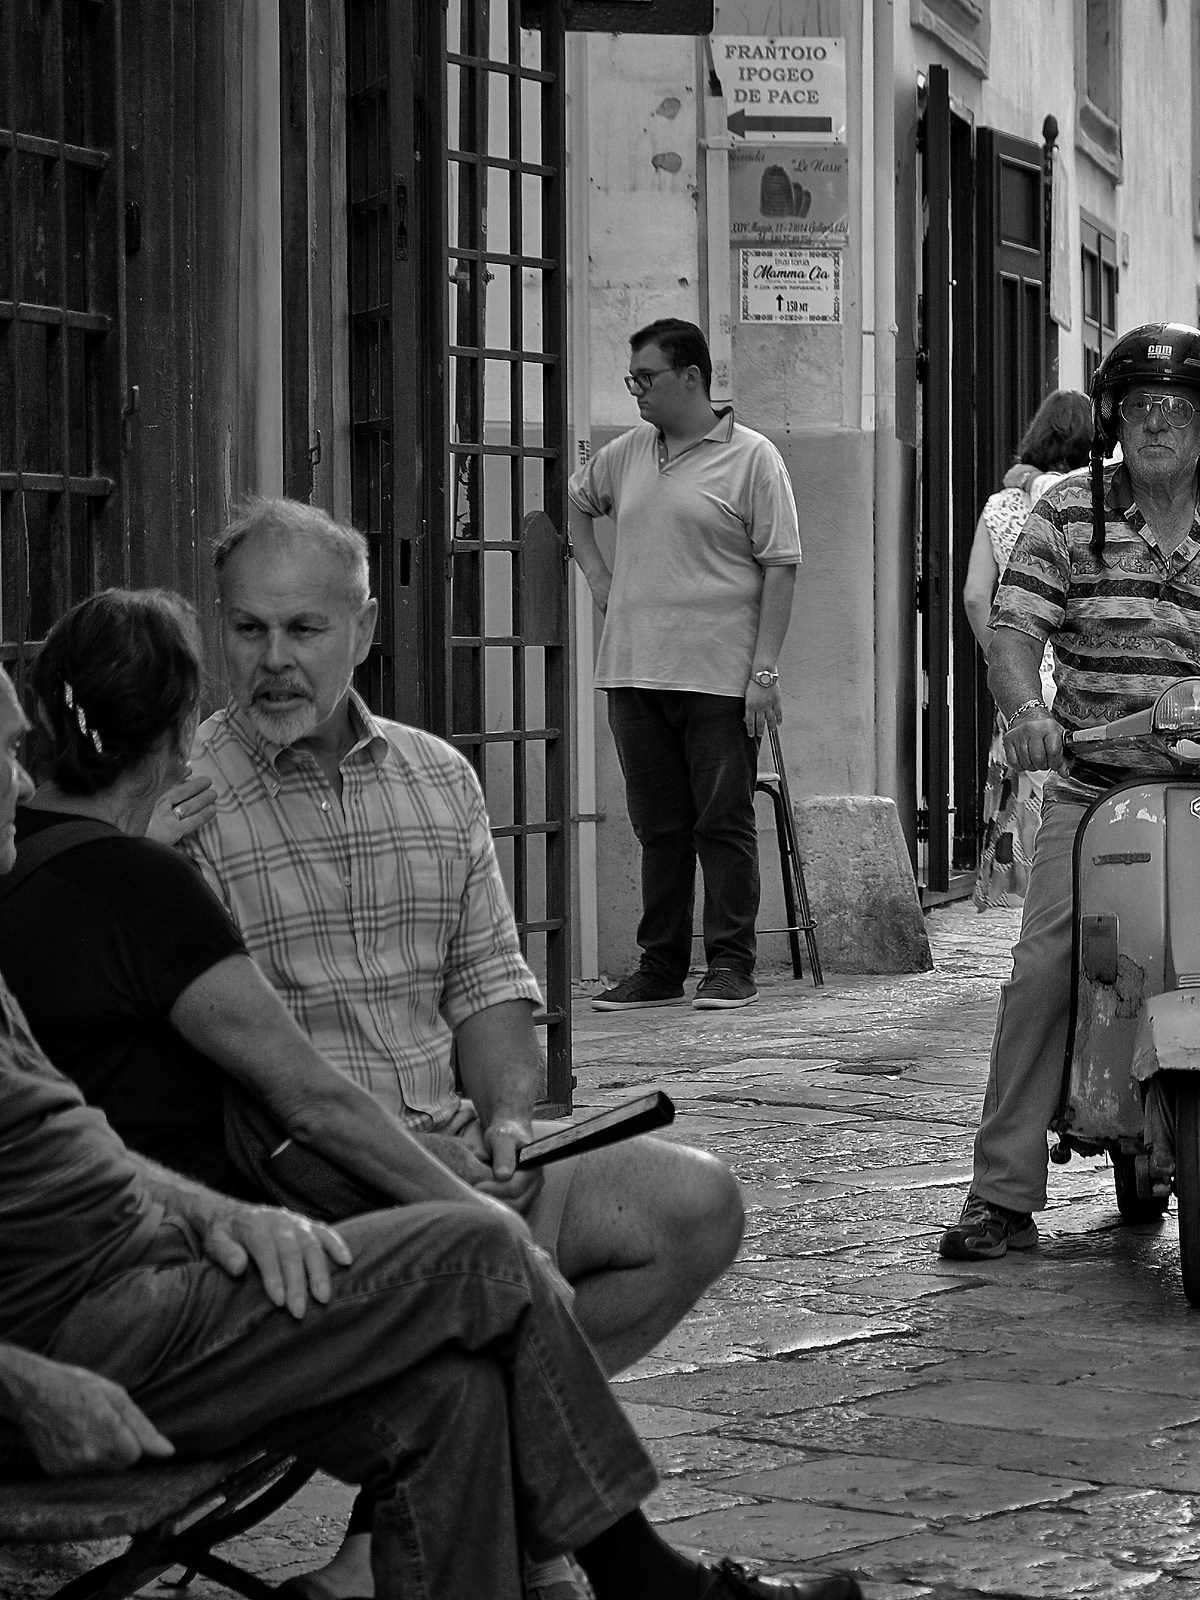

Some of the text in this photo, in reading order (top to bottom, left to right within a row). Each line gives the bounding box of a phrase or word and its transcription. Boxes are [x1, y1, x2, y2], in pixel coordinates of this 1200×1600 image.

[725, 44, 827, 60] FRANTOIO
[738, 67, 814, 82] IPOGEO
[734, 89, 820, 104] DE PACE
[753, 264, 807, 280] Mamma
[786, 301, 798, 313] 150
